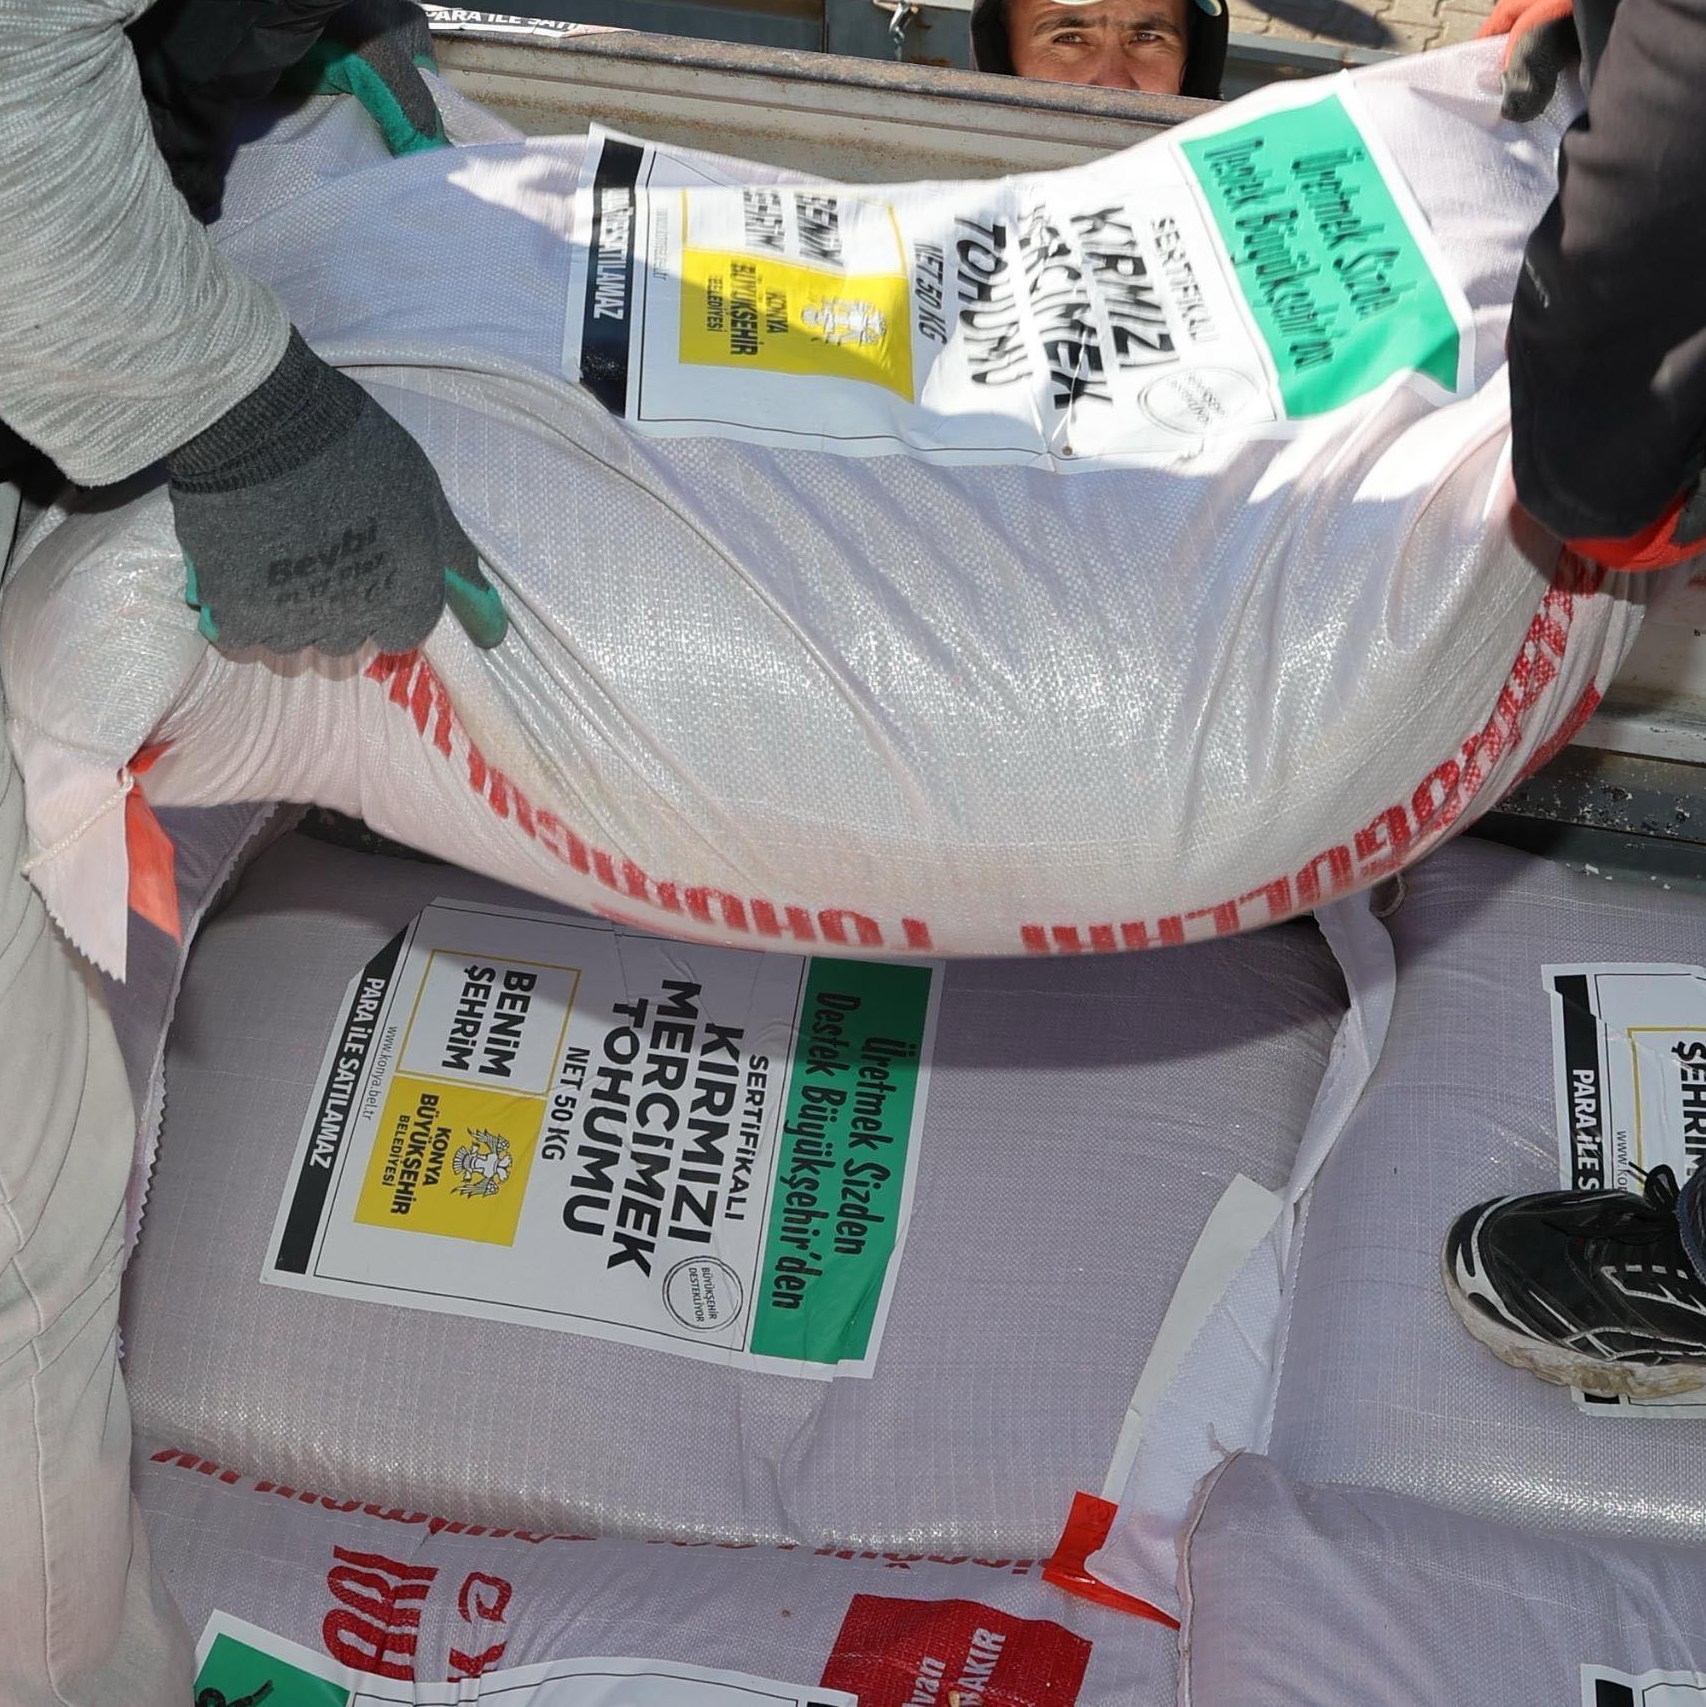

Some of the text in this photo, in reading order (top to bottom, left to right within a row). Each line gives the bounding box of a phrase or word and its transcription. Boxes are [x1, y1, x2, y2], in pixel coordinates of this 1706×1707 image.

[1070, 206, 1181, 373] KIRMIZI
[309, 976, 387, 1170] PARA İLE SATILAMAZ
[362, 1025, 398, 1121] www.konya.bel.tr
[440, 964, 497, 1071] ŞEHRİM
[478, 969, 538, 1078] BENİM
[381, 1114, 411, 1187] BELEDİYESİ
[389, 1092, 440, 1216] BÜYÜKŞEHİR
[421, 1126, 453, 1186] KONYA
[541, 1045, 592, 1162] NET 50 KG
[561, 997, 649, 1238] TOHUMU
[606, 979, 703, 1279] MERCİMEK
[666, 1022, 745, 1244] KIRMIZI
[724, 1053, 770, 1221] SERTİFİKALI
[771, 991, 862, 1311] Destek Büyükşehir'den
[833, 1036, 917, 1256] Üretmek Sizden
[1573, 1069, 1597, 1129] PARA
[1577, 1130, 1603, 1171] İLE
